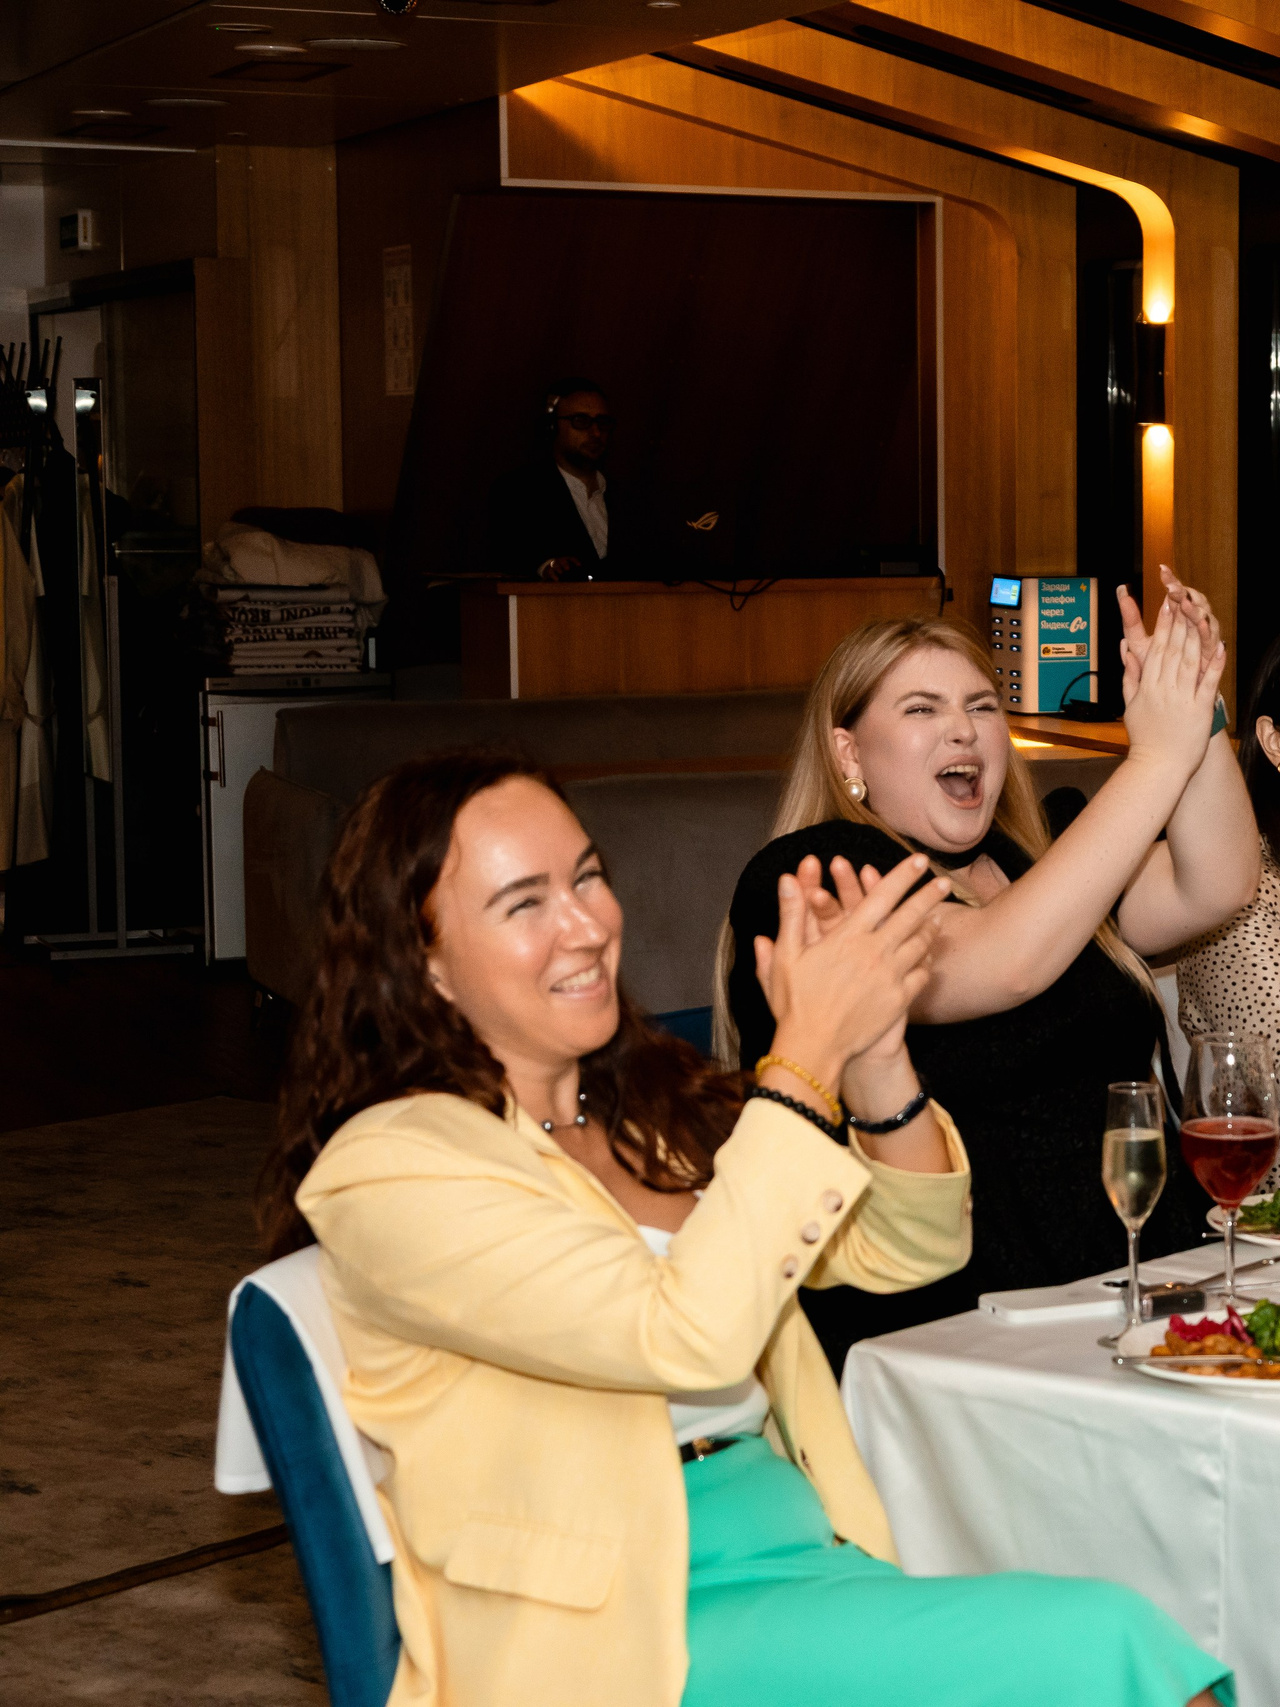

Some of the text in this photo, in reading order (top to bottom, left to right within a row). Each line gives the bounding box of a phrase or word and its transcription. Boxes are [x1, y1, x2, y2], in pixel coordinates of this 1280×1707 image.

[1041, 582, 1070, 592] Заряди
[1041, 595, 1075, 604] телефон
[1041, 609, 1064, 617] через
[1041, 616, 1087, 632] Яндекс Go
